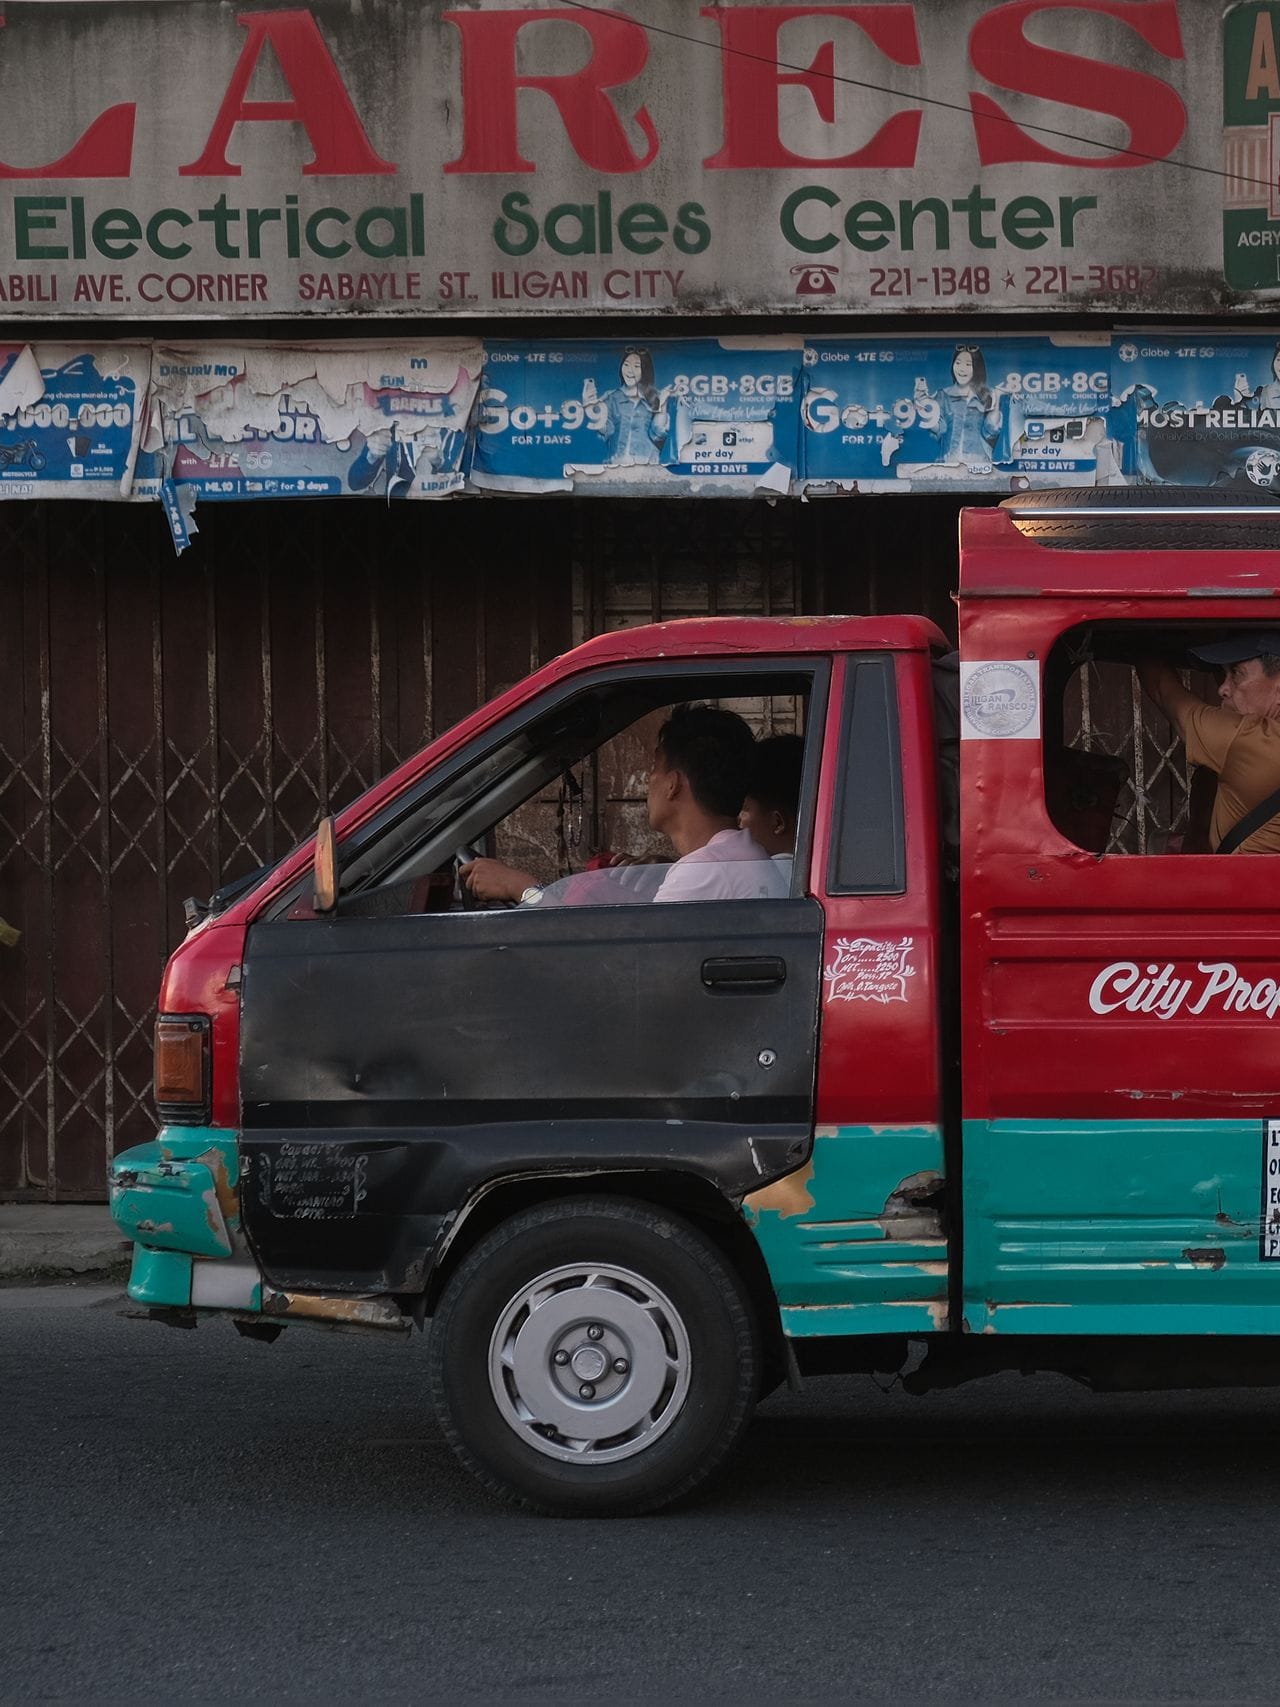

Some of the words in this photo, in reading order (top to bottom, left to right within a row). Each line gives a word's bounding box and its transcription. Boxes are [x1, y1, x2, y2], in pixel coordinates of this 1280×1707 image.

[14, 192, 425, 260] Electrical
[493, 190, 711, 257] Sales
[780, 184, 1098, 254] Center
[74, 274, 131, 302] AVE.
[138, 273, 268, 302] CORNER
[300, 271, 421, 301] SABAYLE
[491, 271, 588, 300] ILIGAN
[603, 269, 685, 298] CITY
[869, 265, 990, 296] 221-1348
[490, 353, 520, 363] Globe
[820, 352, 850, 362] Globe
[879, 351, 894, 362] 5G
[1140, 348, 1170, 358] Globe
[215, 364, 237, 376] MO
[512, 436, 533, 445] FOR
[535, 436, 541, 444] 7
[543, 435, 572, 444] DAYS
[842, 435, 864, 444] FOR
[867, 435, 873, 444] 7
[695, 451, 712, 460] per
[715, 449, 734, 460] day
[1021, 447, 1038, 456] per
[1042, 446, 1061, 456] day
[691, 465, 711, 473] FOR
[713, 465, 719, 473] 2
[721, 464, 748, 473] DAYS
[1018, 461, 1037, 470] FOR
[1040, 461, 1046, 470] 2
[1048, 461, 1075, 470] DAYS
[281, 482, 295, 490] for
[1090, 961, 1191, 1020] City
